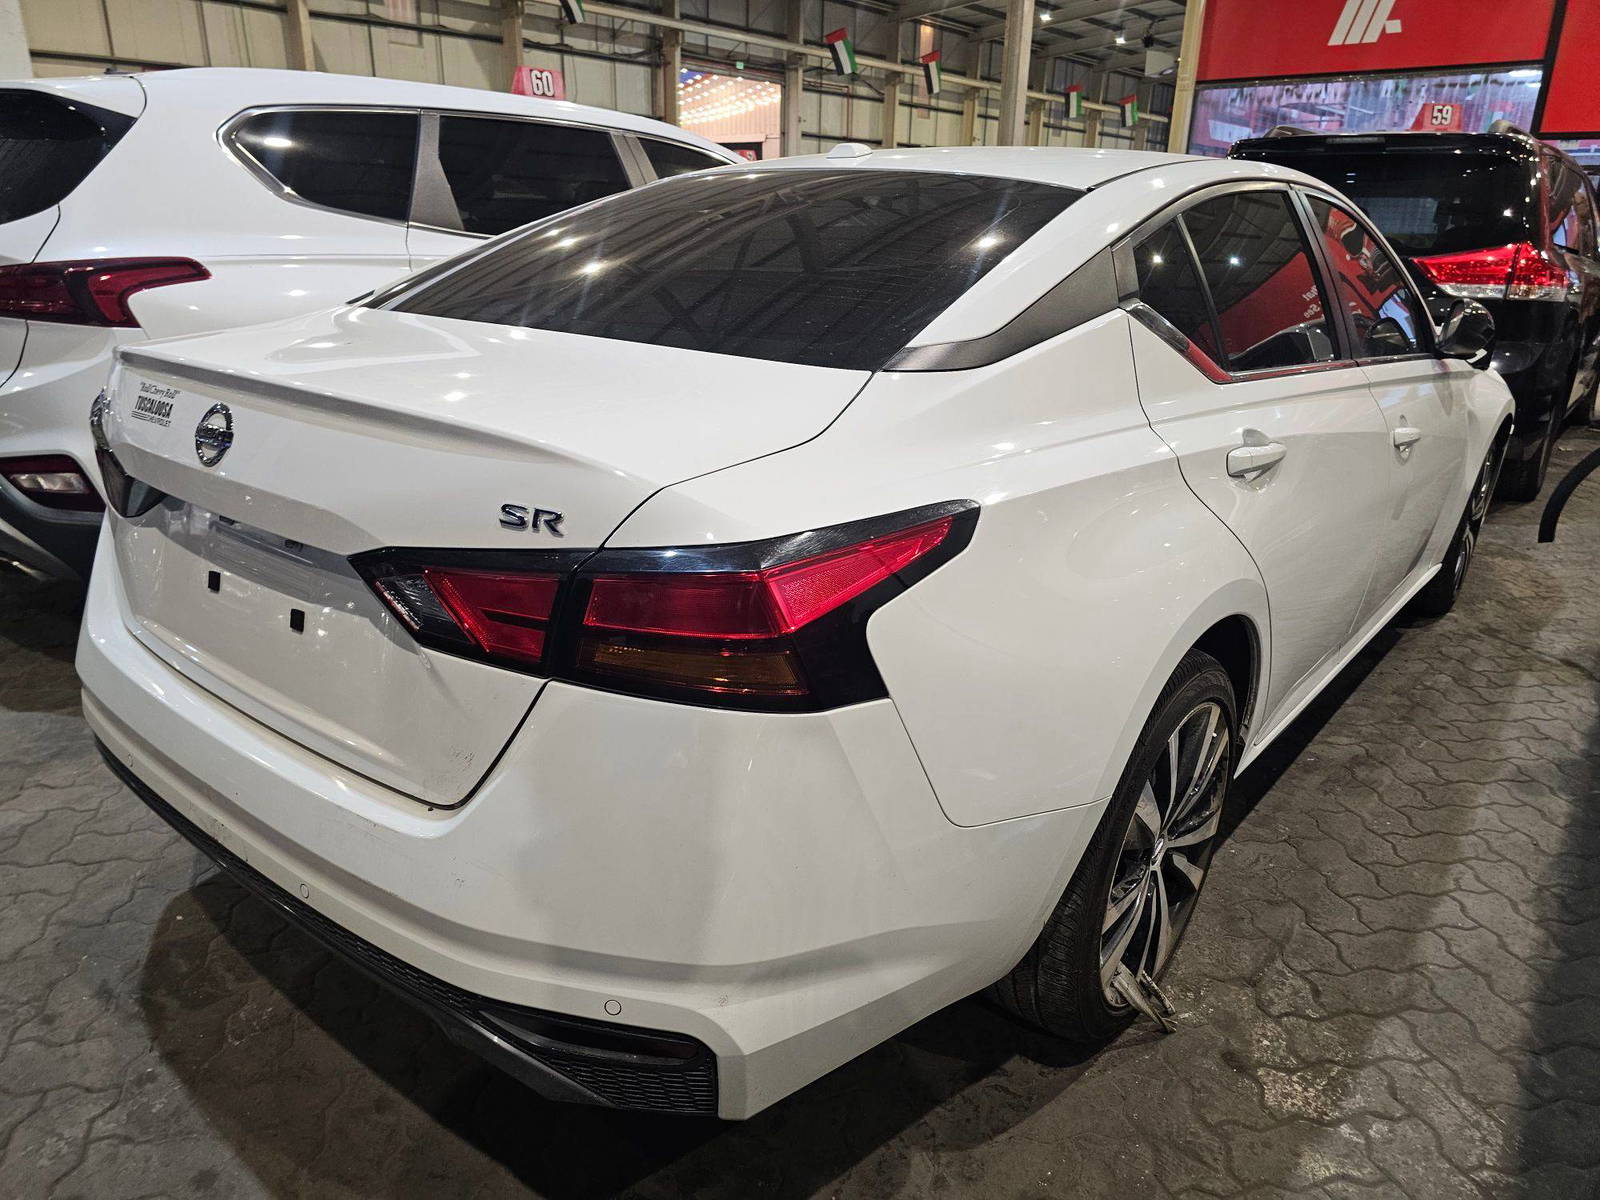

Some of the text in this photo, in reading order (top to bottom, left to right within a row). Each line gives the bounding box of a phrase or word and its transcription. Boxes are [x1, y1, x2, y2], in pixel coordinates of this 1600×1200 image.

[530, 69, 555, 97] 60
[1431, 104, 1453, 126] 59
[135, 395, 174, 419] TUSCALOOSA
[499, 503, 564, 538] SR
